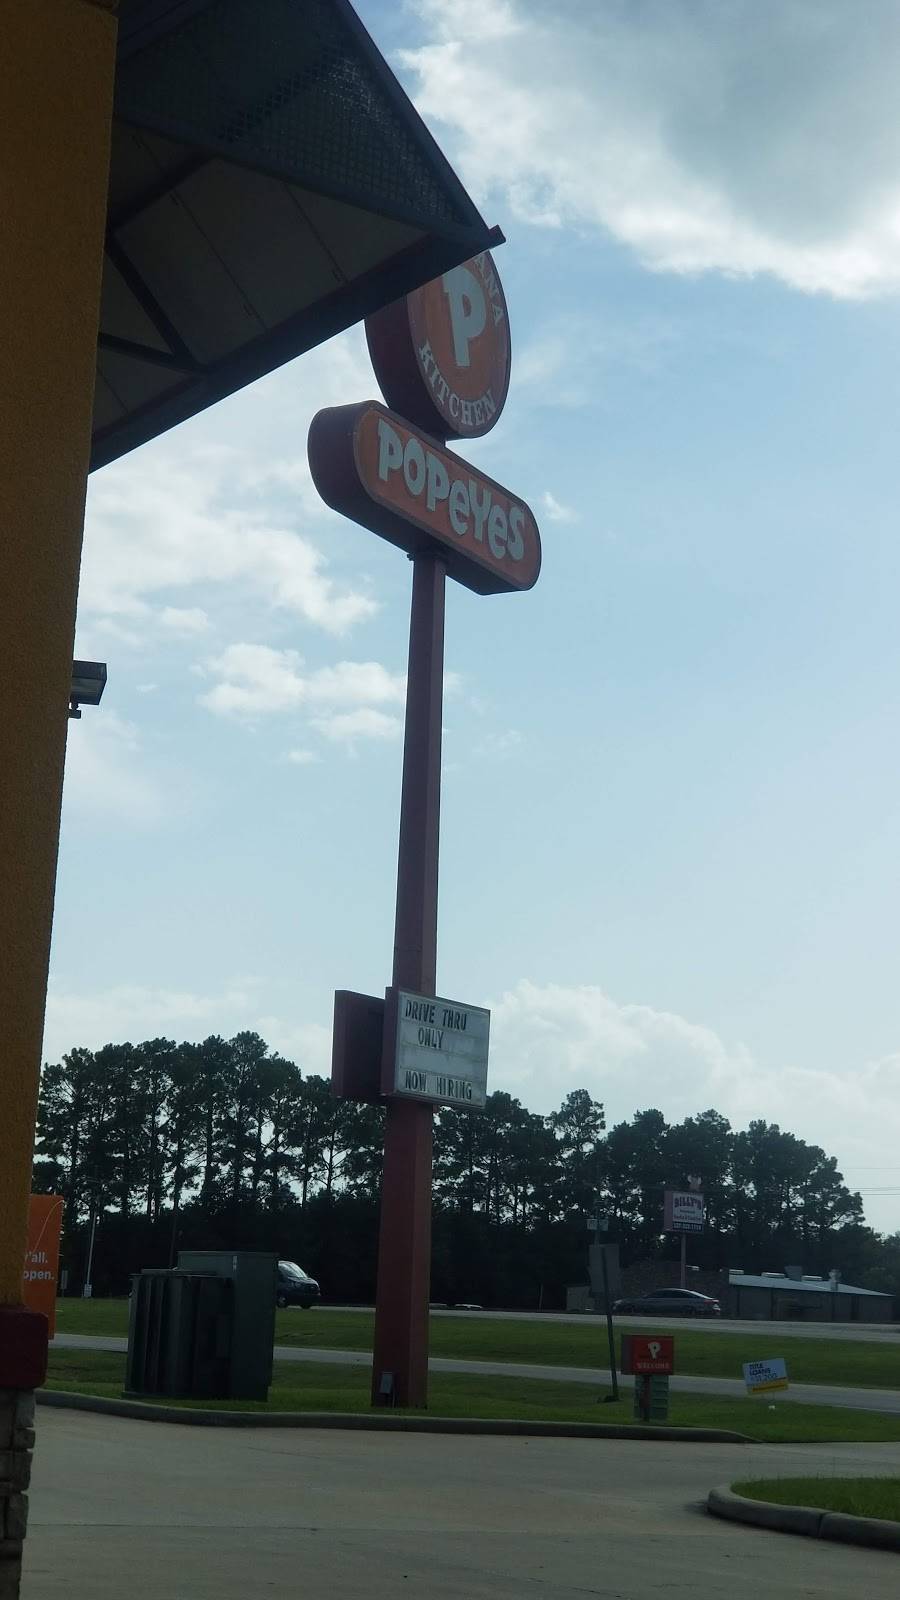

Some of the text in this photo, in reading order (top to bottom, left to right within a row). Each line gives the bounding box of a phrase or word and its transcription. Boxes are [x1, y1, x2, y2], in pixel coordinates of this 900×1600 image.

[443, 265, 486, 367] P
[418, 338, 496, 426] KITCHEN
[405, 1000, 468, 1031] DRIVE THRU
[418, 1027, 445, 1049] ONLY
[405, 1070, 472, 1101] NOW HIRING
[648, 1342, 661, 1360] P
